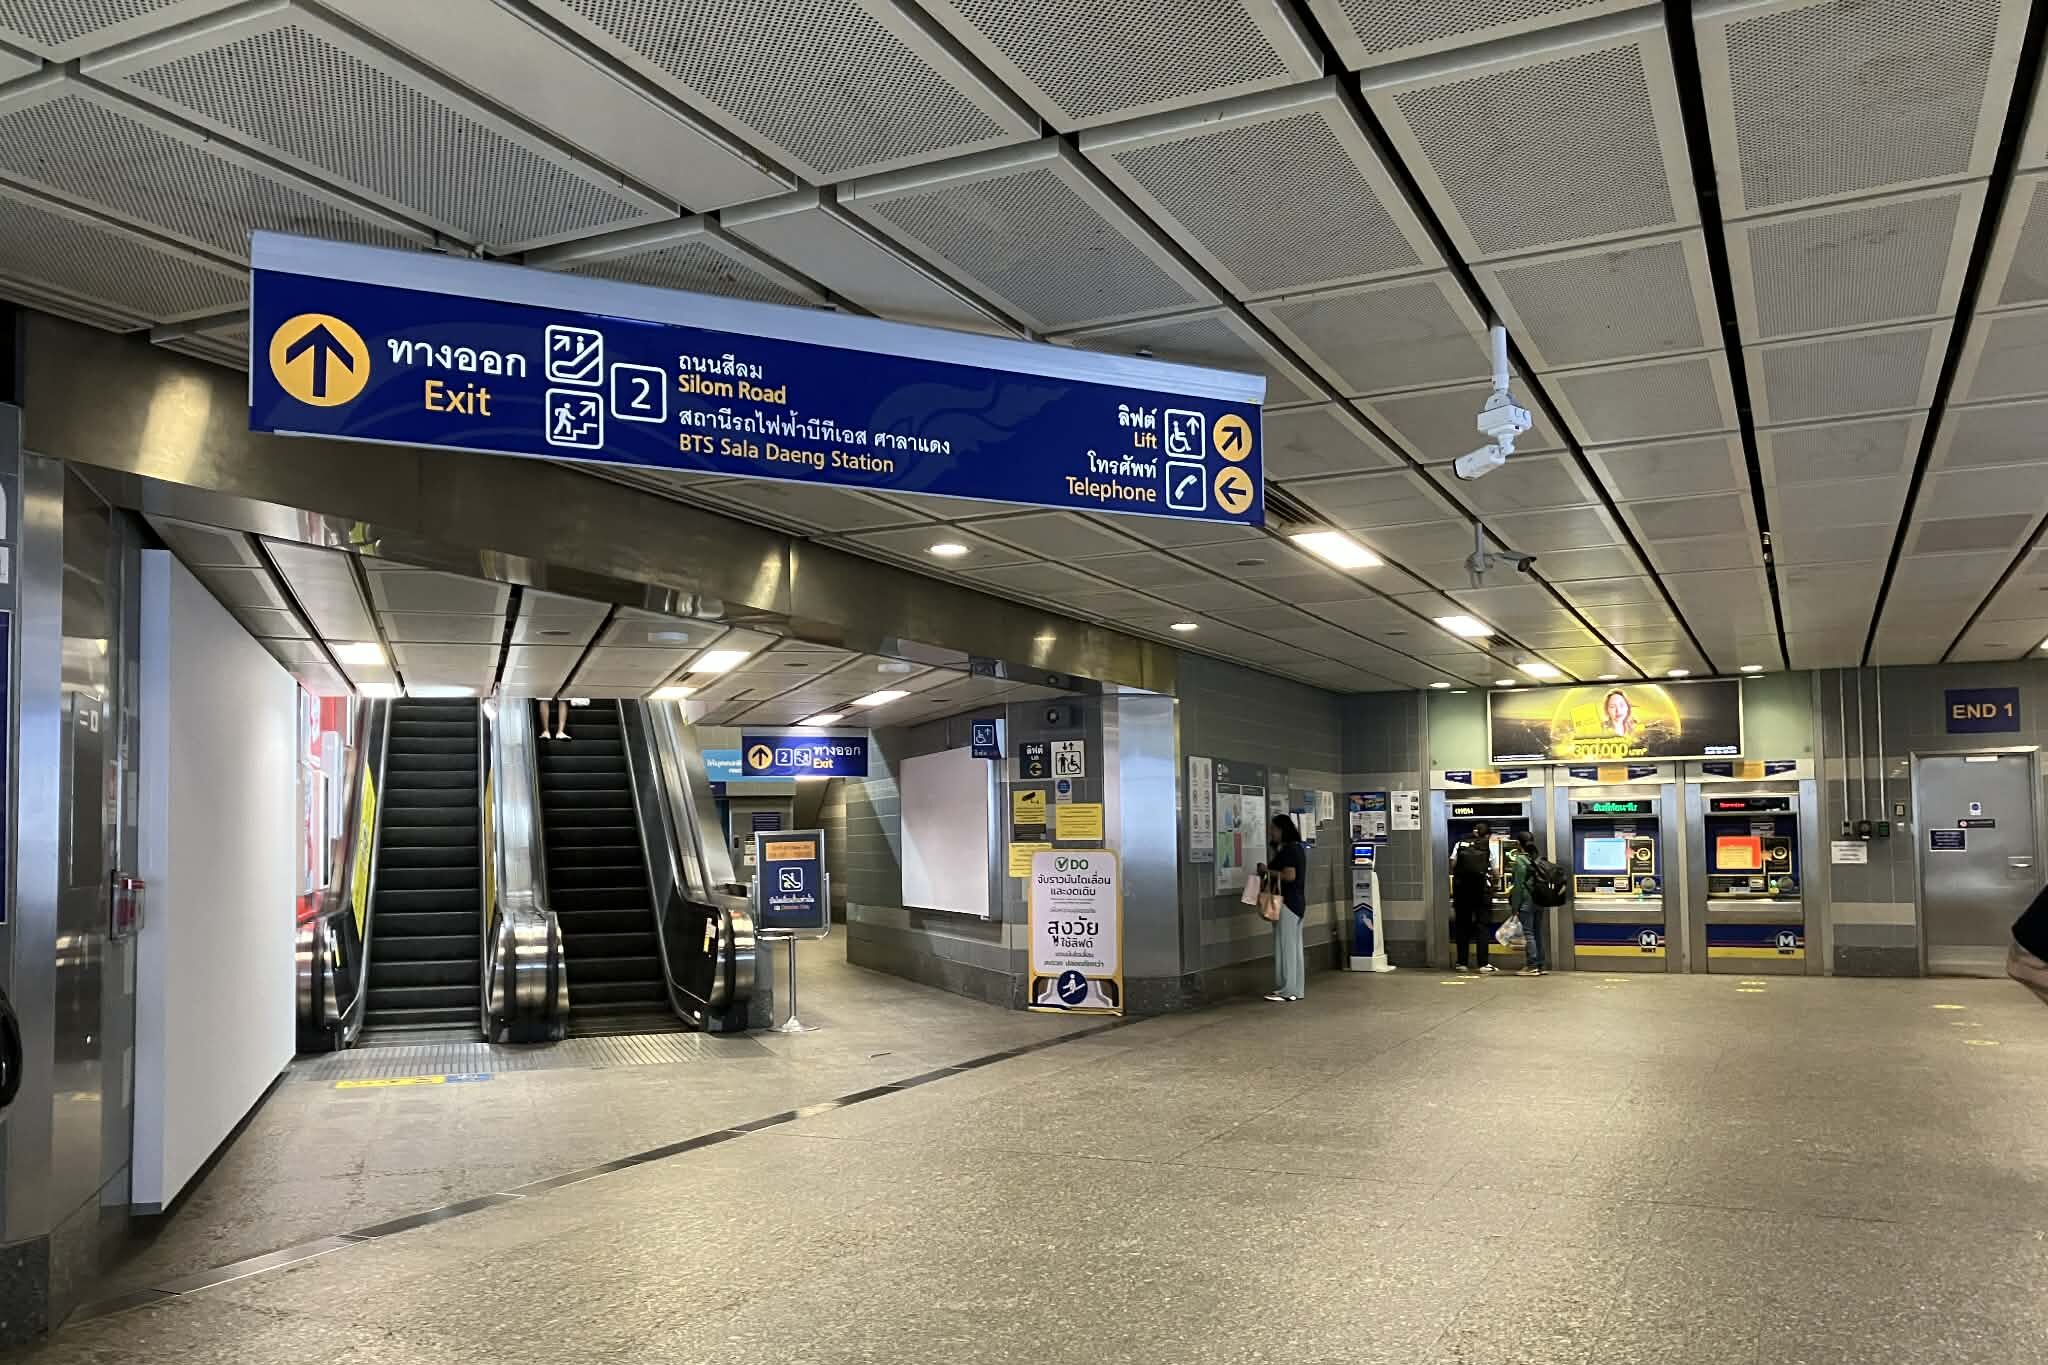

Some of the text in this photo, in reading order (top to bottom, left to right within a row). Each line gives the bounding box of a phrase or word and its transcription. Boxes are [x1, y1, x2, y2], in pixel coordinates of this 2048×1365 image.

[387, 337, 527, 379] ทางออก
[678, 353, 763, 381] ถนนสีลม
[425, 380, 492, 417] Exit
[631, 377, 652, 410] 2
[678, 373, 787, 405] Silom Road
[1117, 404, 1158, 430] ลิฟต์
[679, 408, 951, 456] สถานีรถไฟฟ้าบีทีเอส ศาลาแดง
[1133, 431, 1158, 449] Lift
[679, 433, 894, 474] BTS Sala Daeng Station
[1086, 450, 1158, 479] โทรศัพท์
[1065, 475, 1158, 503] Telephone
[1952, 702, 2014, 720] END 1
[780, 752, 788, 763] 2
[813, 744, 861, 757] ทางออก
[813, 758, 834, 769] Exit
[1038, 872, 1111, 885] จับราวบันไดเลื่อน
[1070, 859, 1089, 870] DO
[1047, 915, 1099, 947] สูงวัย
